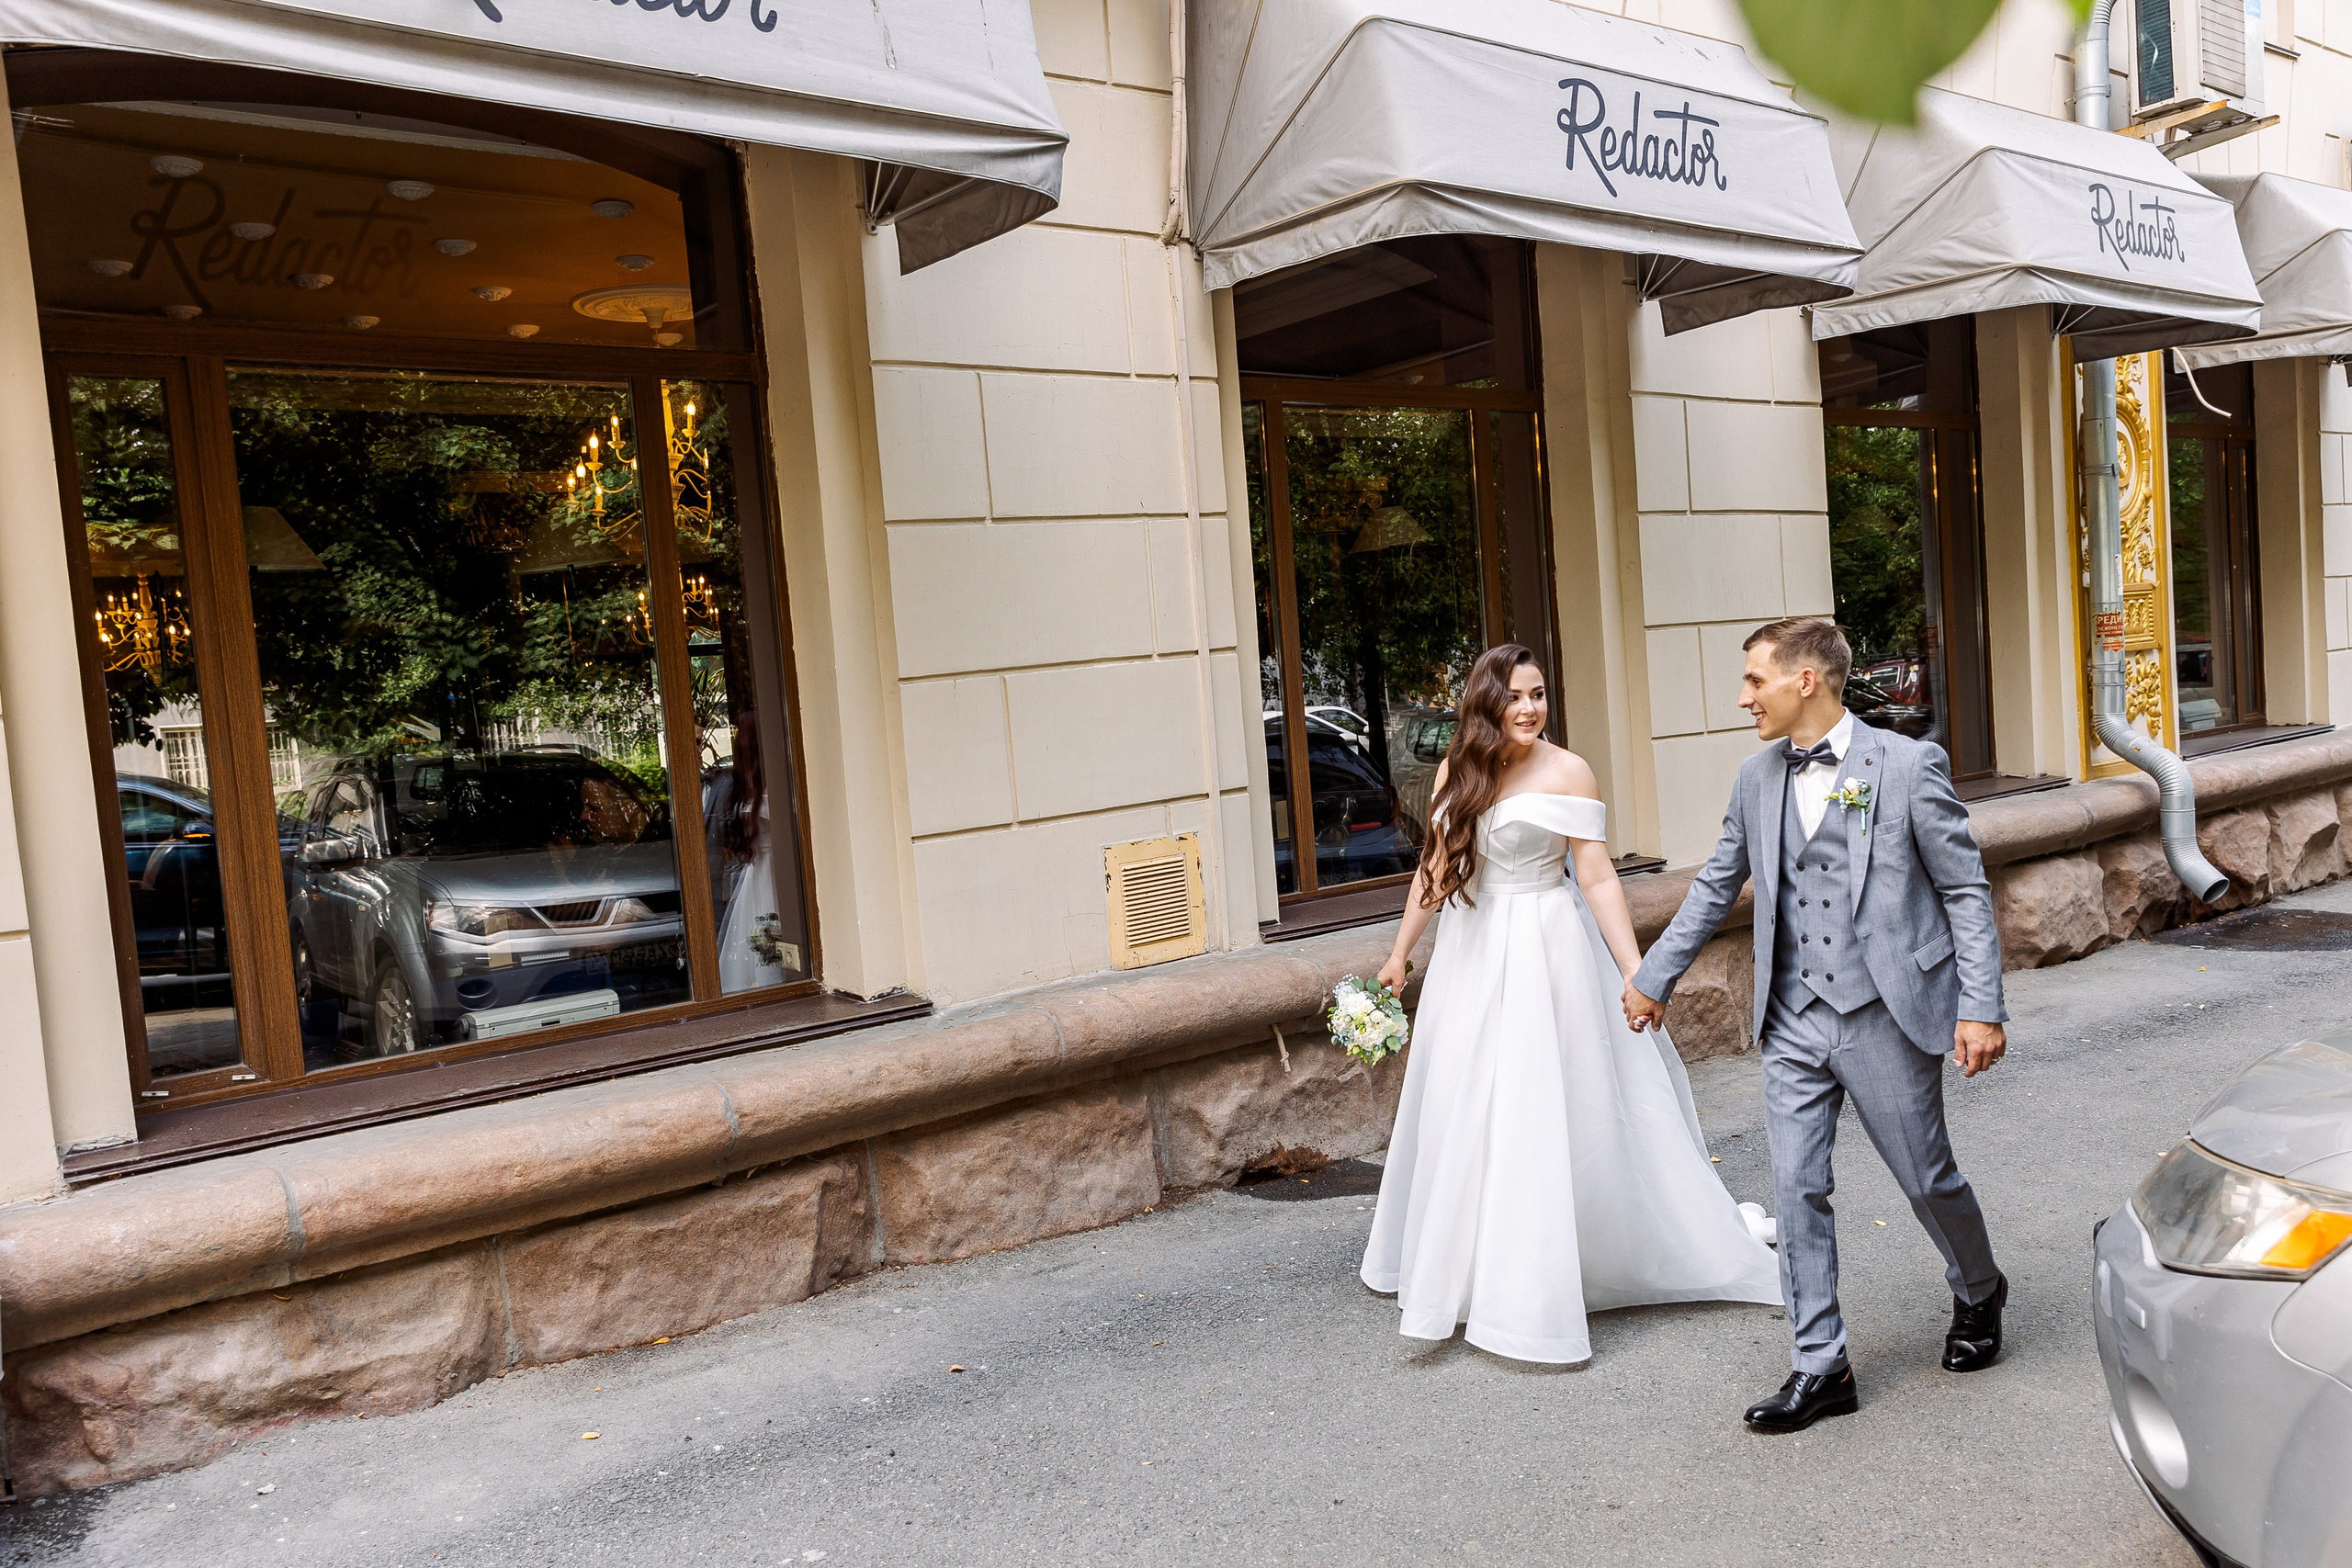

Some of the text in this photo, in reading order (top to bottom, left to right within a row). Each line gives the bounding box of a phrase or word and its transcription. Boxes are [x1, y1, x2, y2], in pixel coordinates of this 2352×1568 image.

[1557, 78, 1727, 197] Redactor
[130, 174, 430, 315] Redactor
[2088, 183, 2185, 272] Redactor
